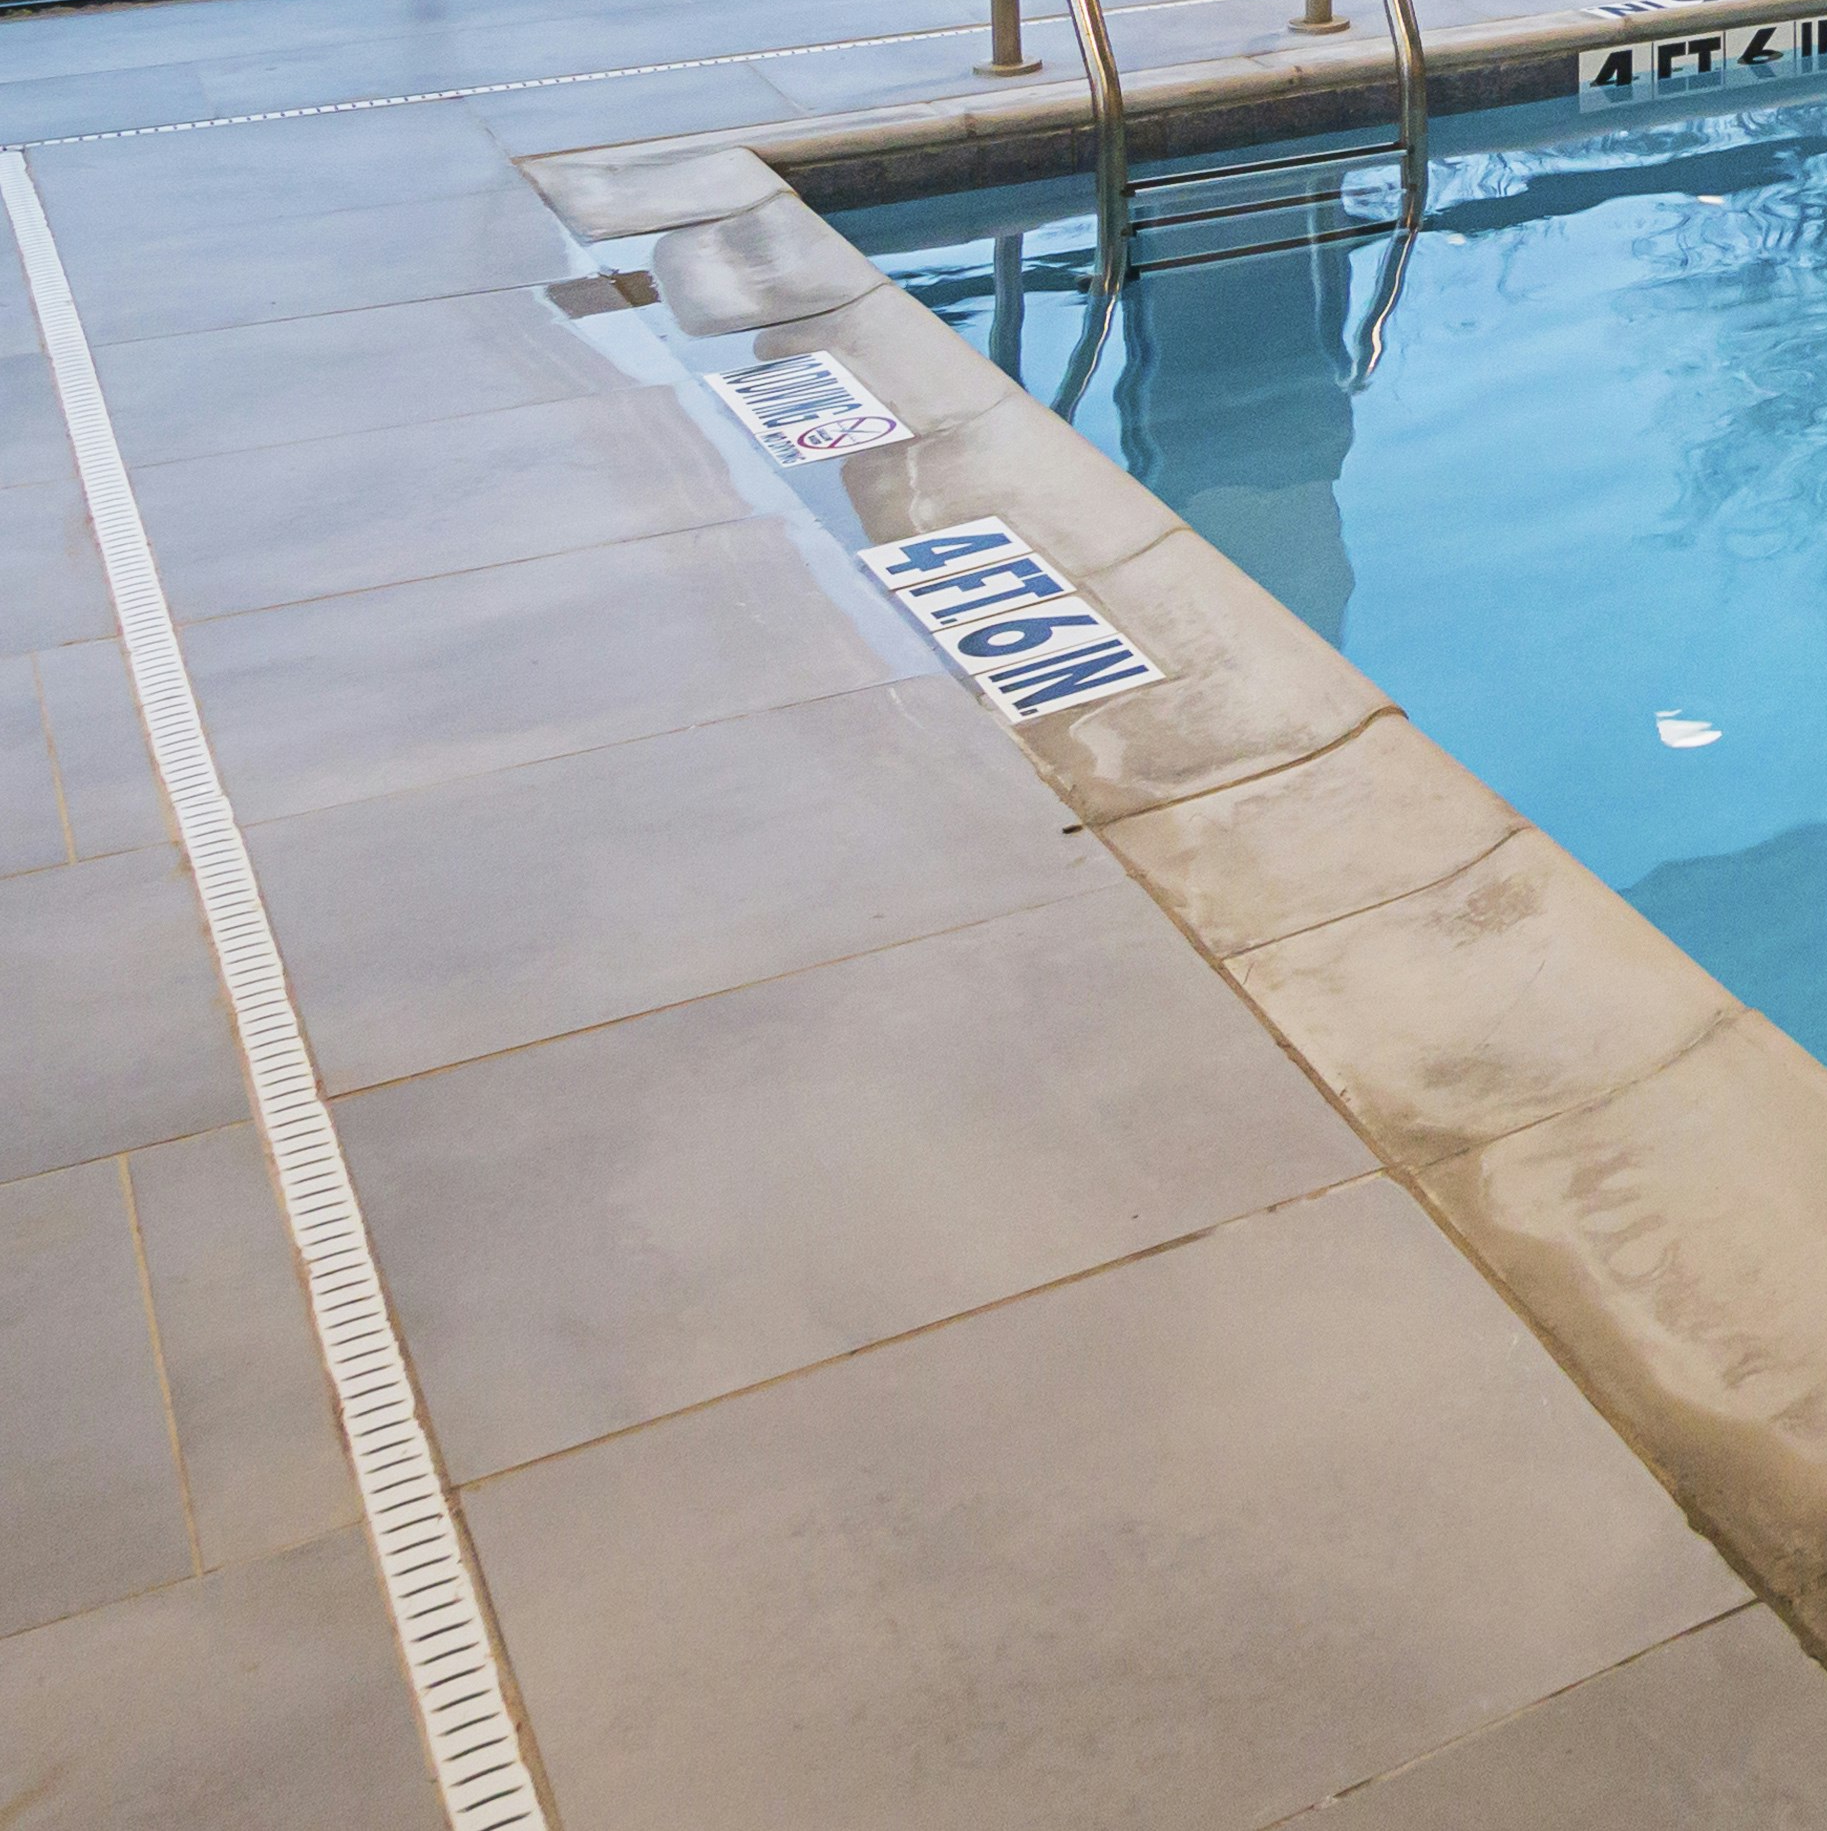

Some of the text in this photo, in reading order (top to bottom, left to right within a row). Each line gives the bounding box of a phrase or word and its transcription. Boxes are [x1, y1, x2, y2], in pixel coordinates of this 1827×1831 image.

[1590, 49, 1639, 87] 4
[1736, 27, 1784, 64] 6
[886, 532, 1150, 716] 4 FT. 6 IN.
